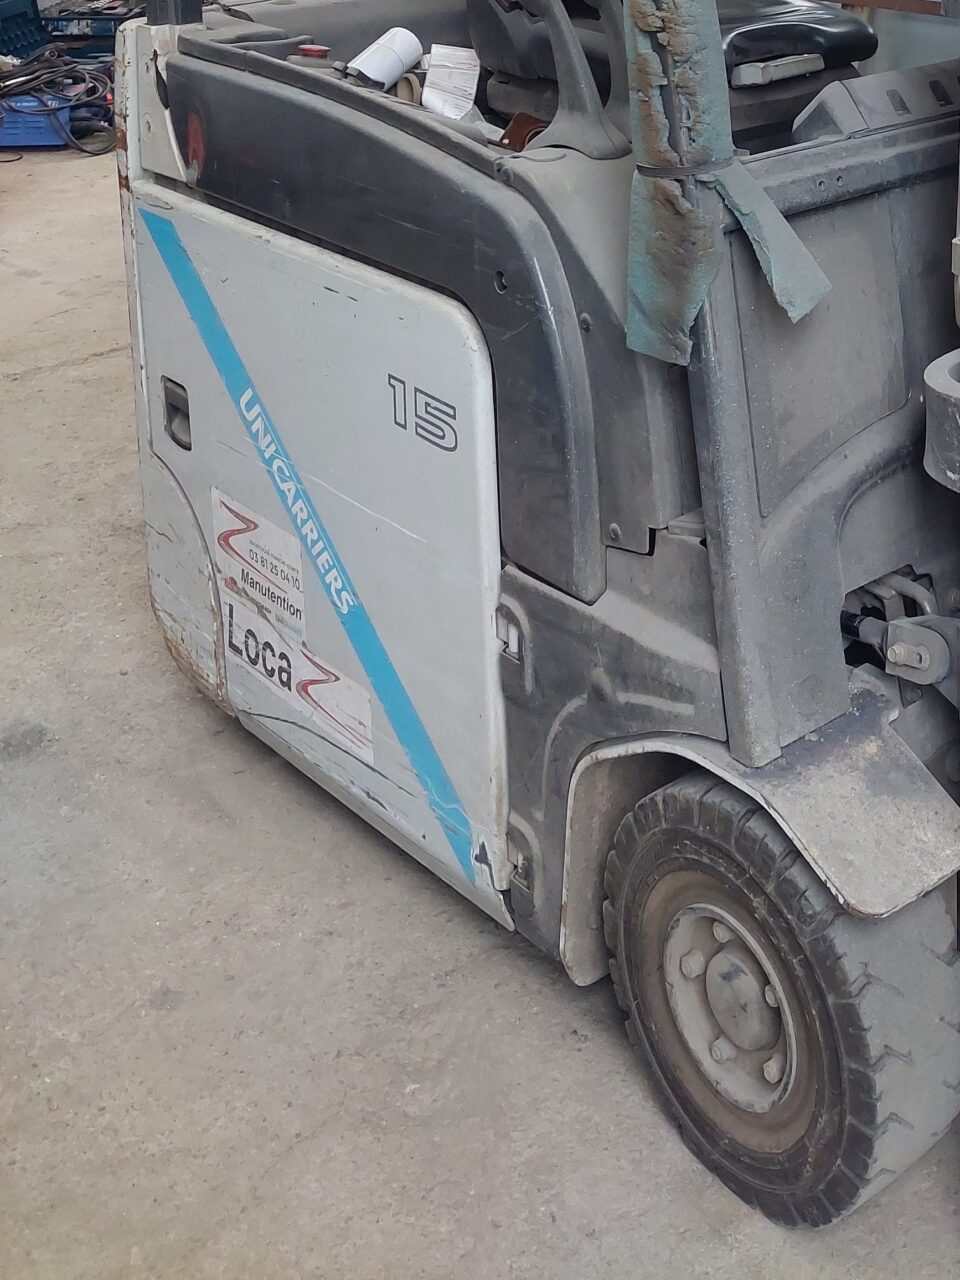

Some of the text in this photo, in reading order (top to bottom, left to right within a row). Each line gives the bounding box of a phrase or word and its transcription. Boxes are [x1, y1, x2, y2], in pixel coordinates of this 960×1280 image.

[387, 372, 458, 454] 15
[240, 387, 356, 615] UNICARRIERS
[241, 568, 302, 621] Manutention
[249, 549, 301, 590] 03 81 25 04 10
[228, 603, 292, 692] Loca
